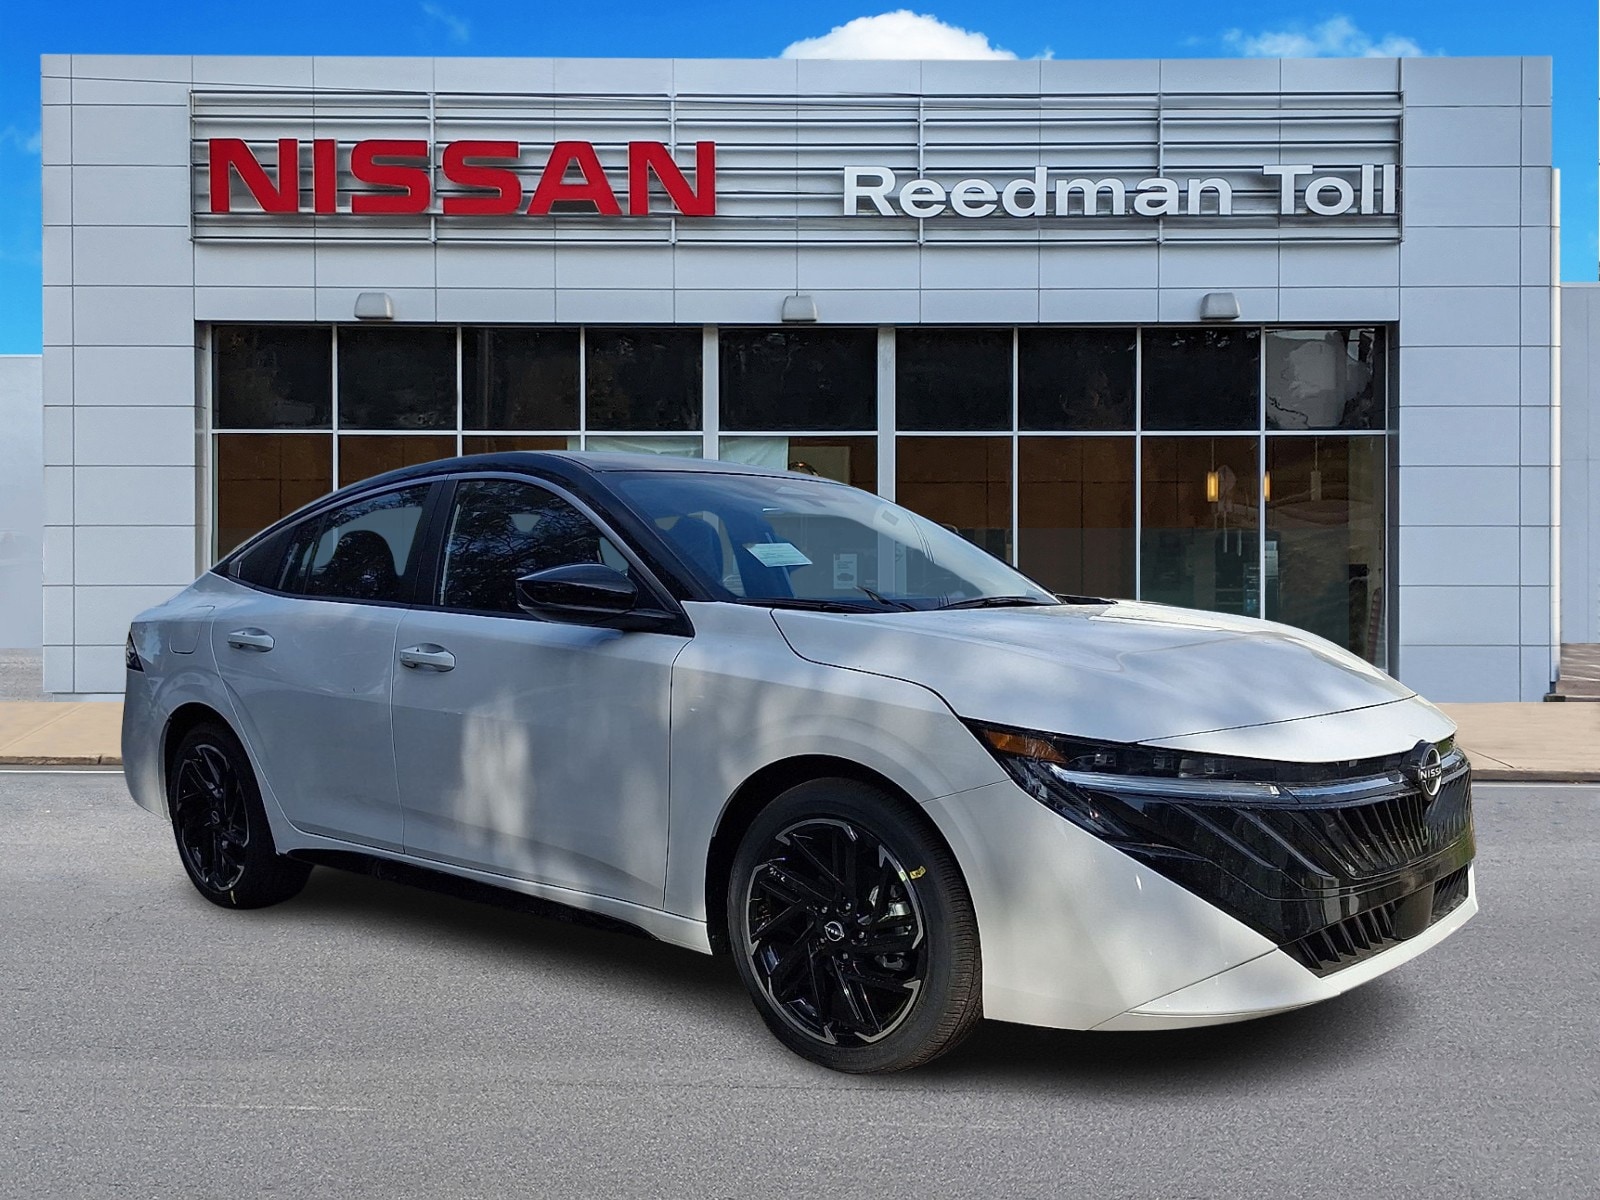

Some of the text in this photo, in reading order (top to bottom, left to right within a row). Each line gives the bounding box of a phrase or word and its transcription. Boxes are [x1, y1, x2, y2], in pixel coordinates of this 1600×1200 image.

[209, 138, 717, 217] NISSAN
[843, 164, 1396, 218] Reedman Toll
[1420, 767, 1442, 780] NISS
